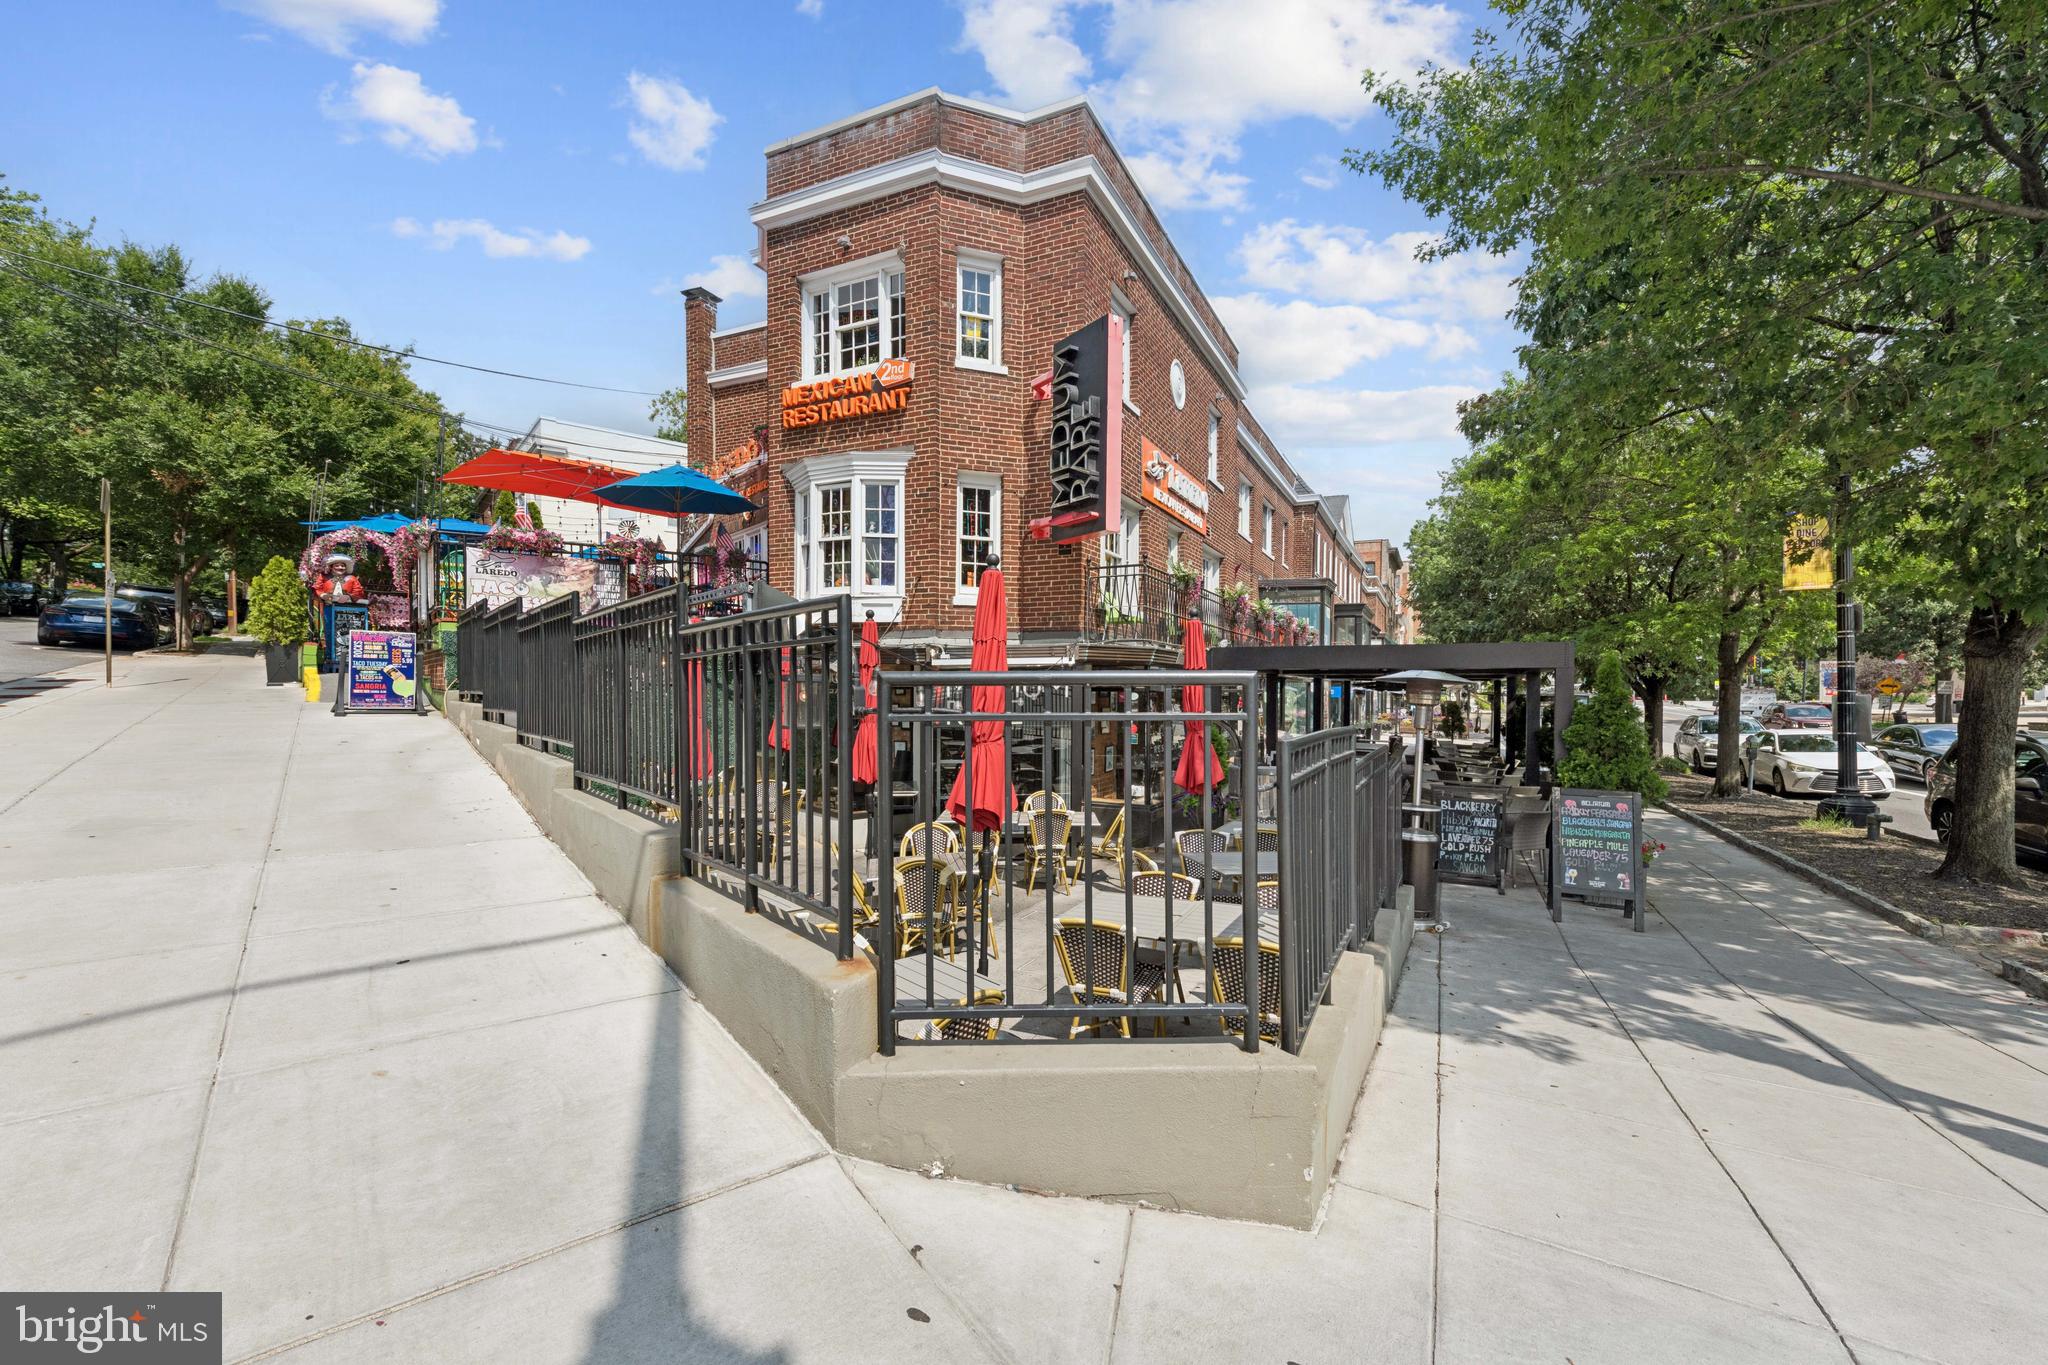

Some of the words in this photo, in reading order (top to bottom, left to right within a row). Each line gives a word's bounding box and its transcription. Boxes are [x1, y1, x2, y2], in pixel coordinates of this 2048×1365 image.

[881, 362, 904, 380] 2nd
[782, 371, 873, 408] MEXICAN
[782, 387, 912, 430] RESTAURANT
[1050, 344, 1079, 509] MEDIUM
[1070, 394, 1101, 503] RARE
[1796, 518, 1819, 526] SHOP
[1796, 528, 1817, 537] DINE
[475, 567, 518, 577] LAREDO
[470, 578, 530, 596] TACO
[470, 594, 548, 612] MADESS
[1441, 800, 1497, 812] BLACKBERRY
[1440, 842, 1465, 851] GOLD
[1469, 844, 1491, 854] RUSH
[1482, 836, 1494, 846] 75
[1561, 838, 1604, 848] PINEAPPLE
[1606, 841, 1629, 852] MULE
[1464, 852, 1485, 862] PEAR
[1562, 847, 1612, 861] LAVENDER
[1613, 852, 1629, 863] 75
